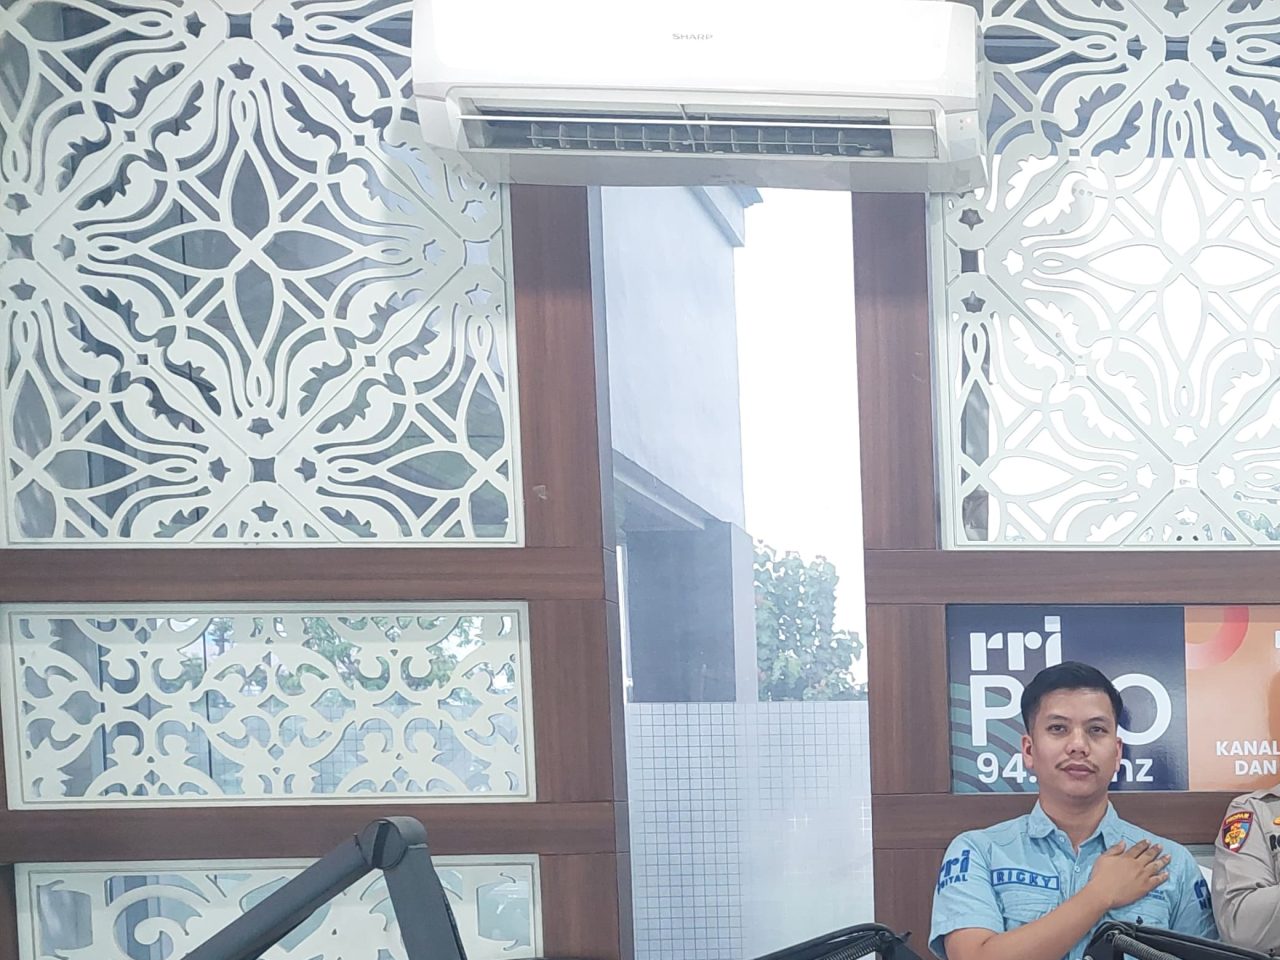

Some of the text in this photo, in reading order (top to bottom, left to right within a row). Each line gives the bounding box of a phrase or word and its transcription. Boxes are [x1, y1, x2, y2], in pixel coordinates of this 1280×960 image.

[969, 615, 1062, 671] rri
[969, 673, 1172, 747] PO
[1215, 740, 1280, 756] KANAL
[1235, 759, 1277, 776] DAN
